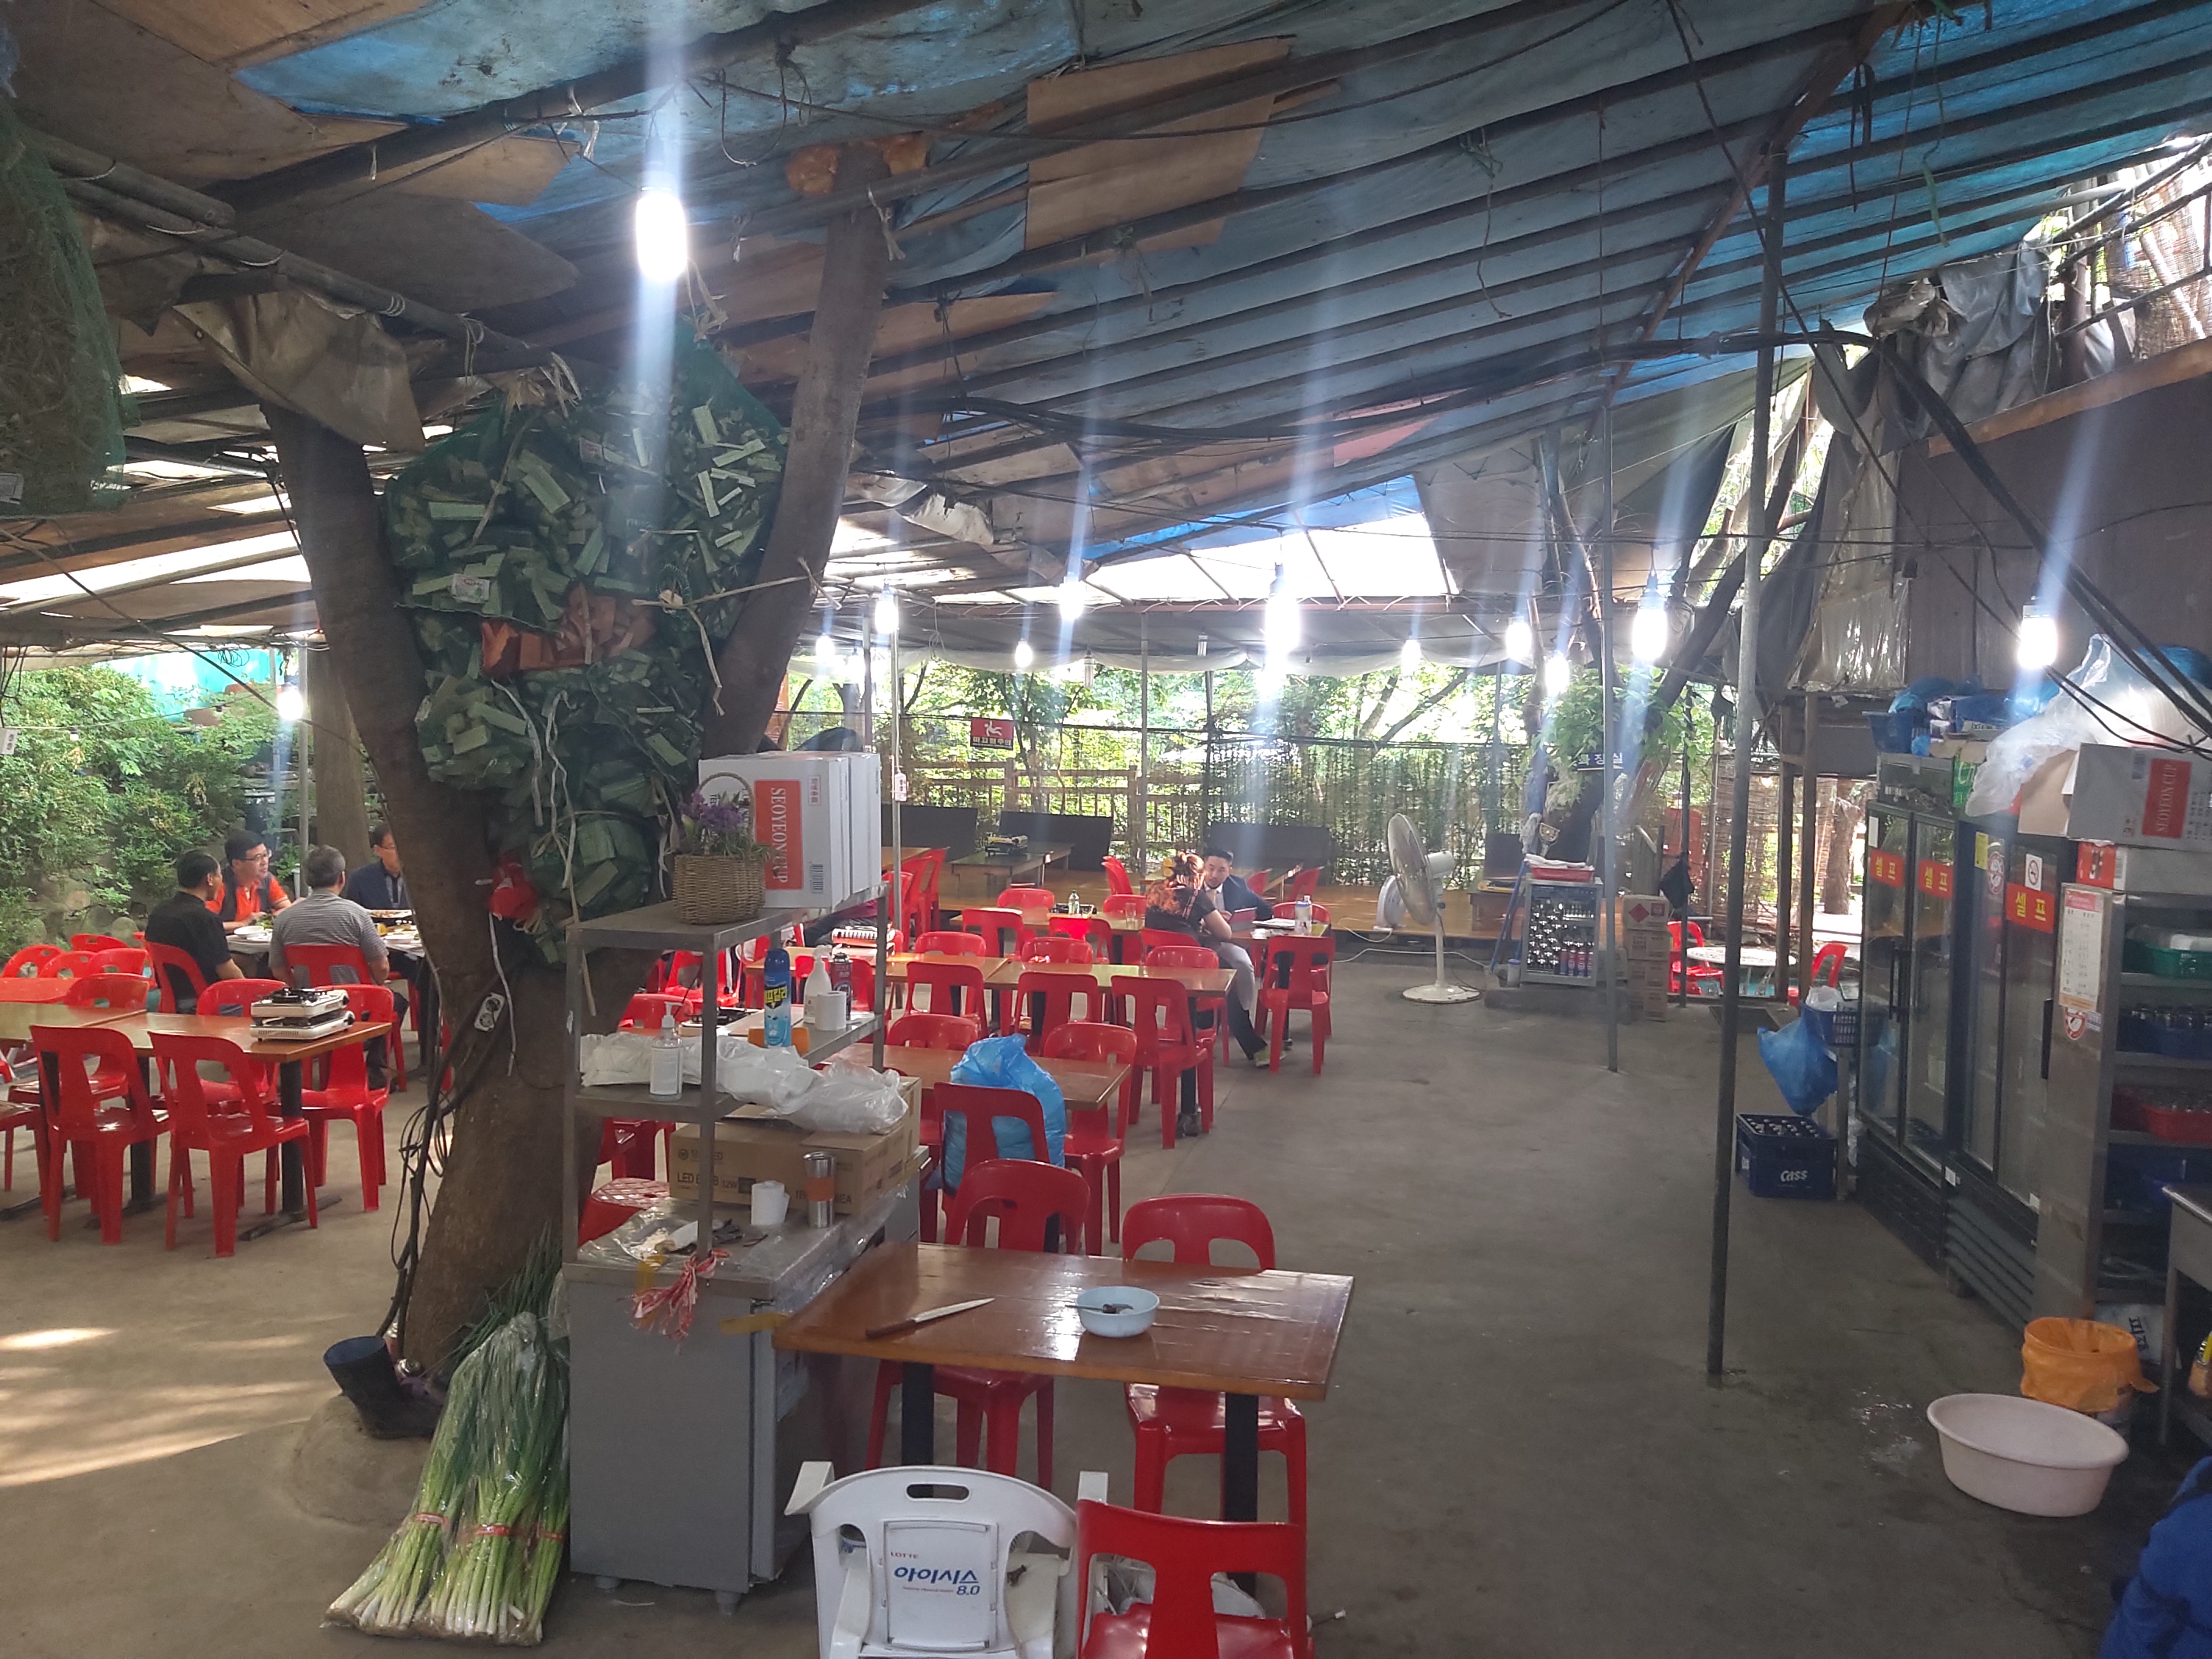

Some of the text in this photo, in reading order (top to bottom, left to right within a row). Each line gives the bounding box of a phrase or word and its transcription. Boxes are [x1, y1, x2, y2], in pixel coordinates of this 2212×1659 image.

[1876, 856, 1896, 880] 셀프
[1924, 866, 1948, 892] 셀프
[2015, 891, 2046, 922] 셀프
[677, 1172, 694, 1183] LED
[894, 1566, 979, 1584] 아이시스
[956, 1585, 981, 1596] 8.0
